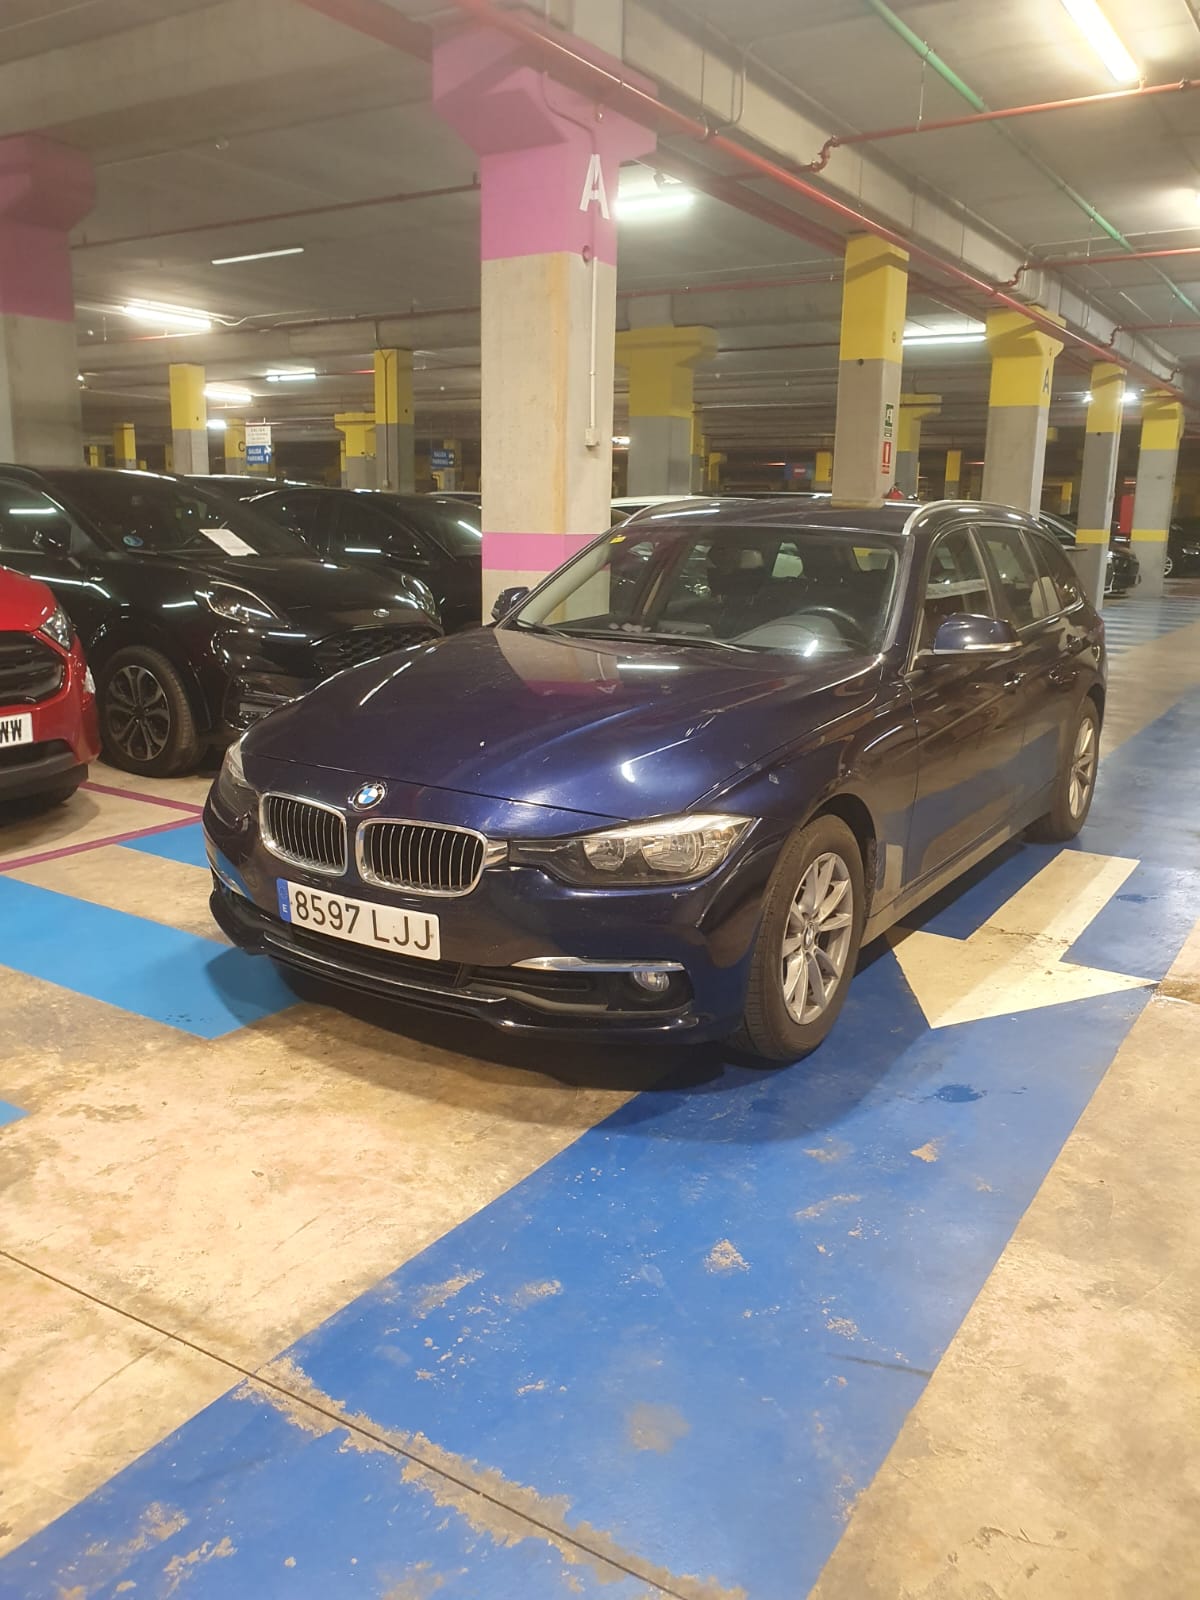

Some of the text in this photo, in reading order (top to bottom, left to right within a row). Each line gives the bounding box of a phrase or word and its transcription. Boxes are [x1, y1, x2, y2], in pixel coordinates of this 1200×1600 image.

[579, 153, 610, 220] A
[1042, 367, 1050, 396] A
[295, 891, 431, 951] 8597 LJJ
